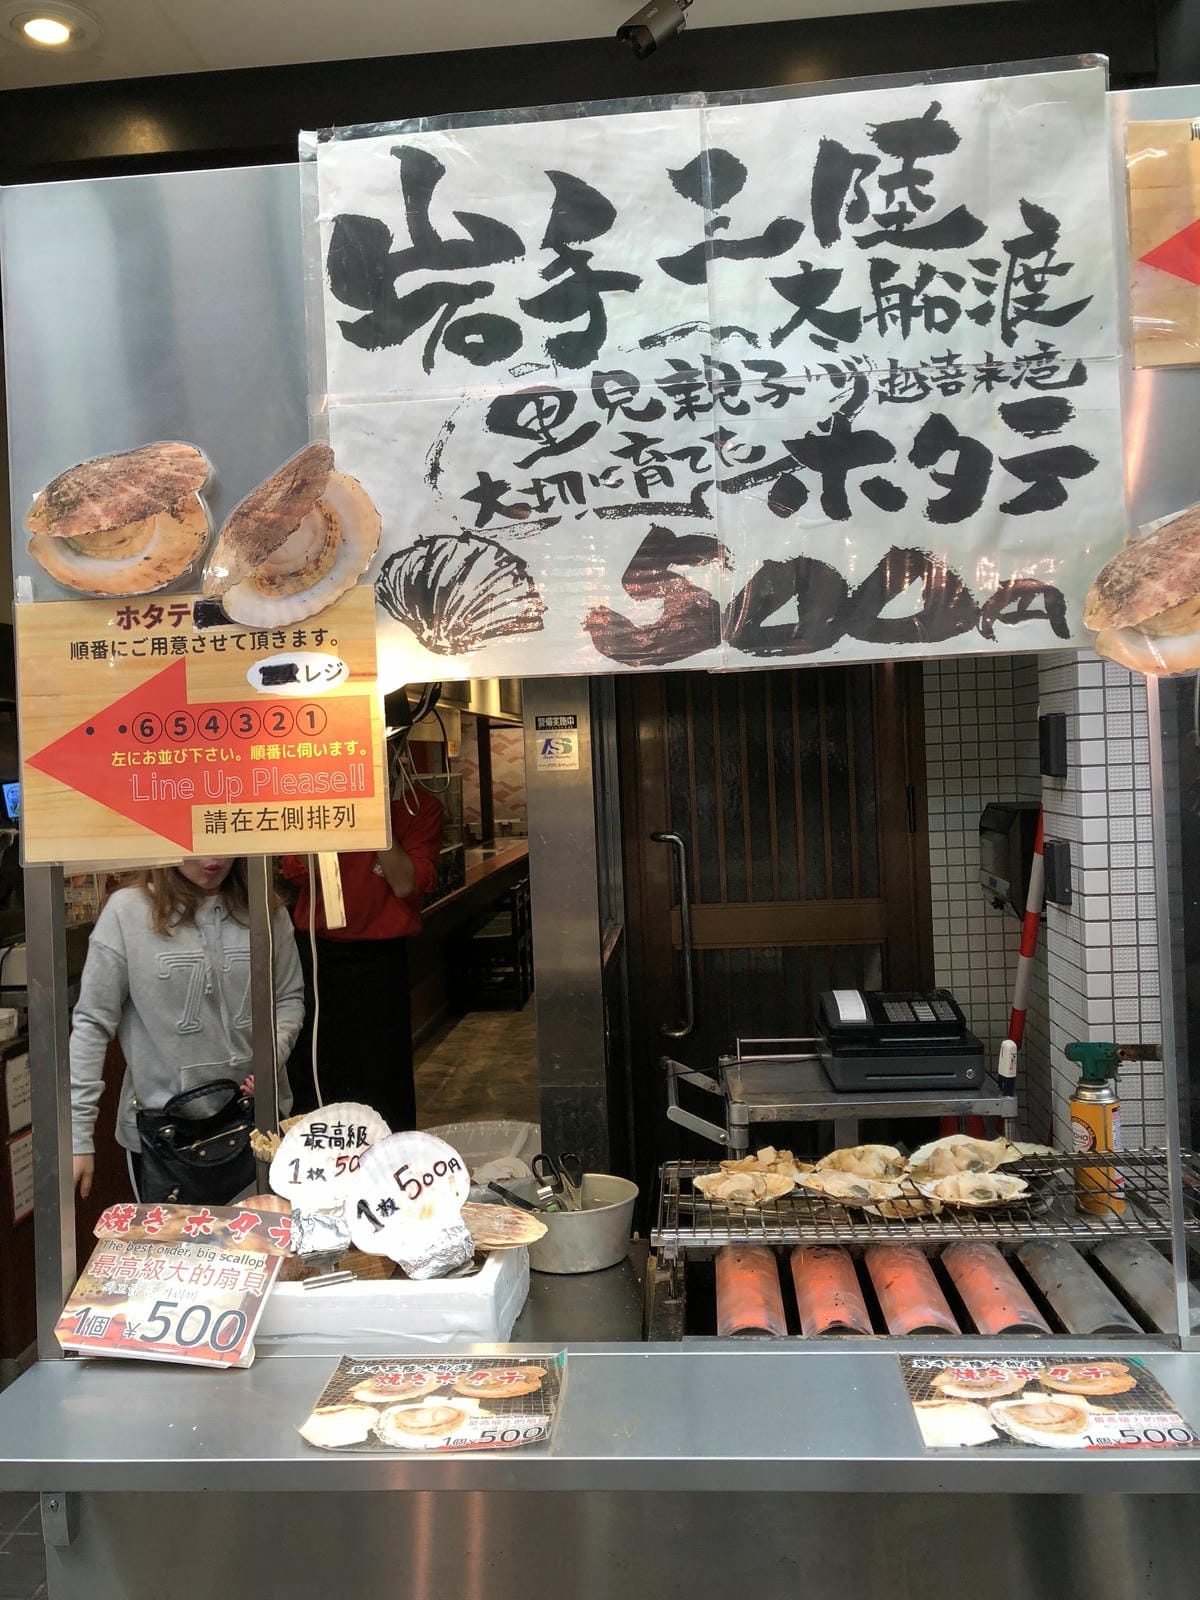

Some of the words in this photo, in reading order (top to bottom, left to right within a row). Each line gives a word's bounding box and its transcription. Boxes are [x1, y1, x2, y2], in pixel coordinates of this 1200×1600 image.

[580, 520, 1072, 668] 500円
[115, 603, 193, 631] ホタテ
[69, 628, 340, 662] 順番にご用意させて頂きます。
[131, 773, 195, 802] Line
[202, 778, 244, 805] Up
[252, 763, 366, 797] Please!!
[203, 803, 357, 835] 請在左側排列
[300, 1120, 371, 1151] 最高級
[393, 1157, 463, 1201] 500円
[102, 1239, 124, 1251] The
[126, 1241, 154, 1253] best
[196, 1247, 217, 1262] big
[219, 1252, 265, 1269] scallop
[89, 1254, 267, 1297] 最高級大的扇貝
